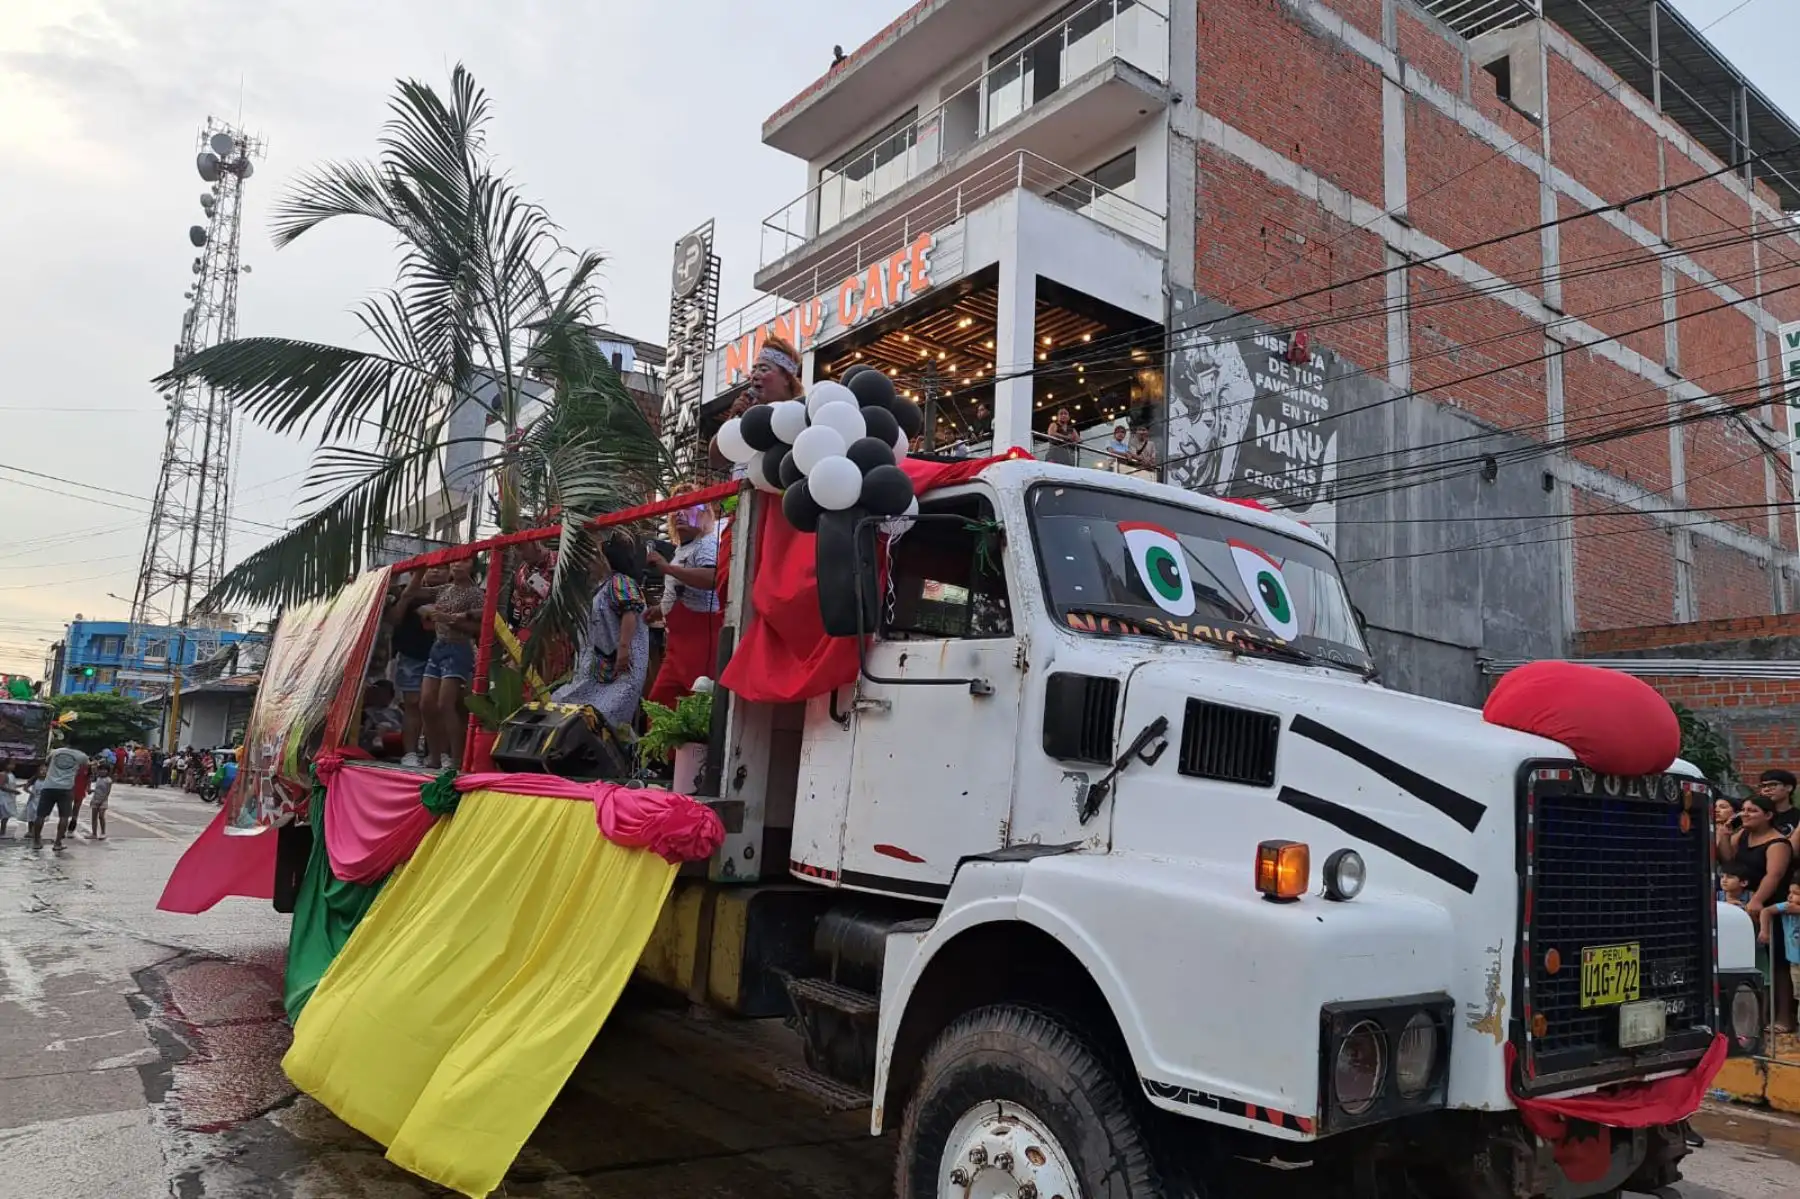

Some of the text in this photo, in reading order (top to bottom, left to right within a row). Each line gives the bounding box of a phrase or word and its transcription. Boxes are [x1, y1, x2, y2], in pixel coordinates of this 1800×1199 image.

[838, 232, 937, 327] CAFÉ
[1254, 330, 1325, 371] DISFTA
[1268, 356, 1323, 391] DE TUS
[1282, 402, 1320, 427] EN TU
[1256, 413, 1323, 465] MANU
[1584, 959, 1637, 997] U1G-722
